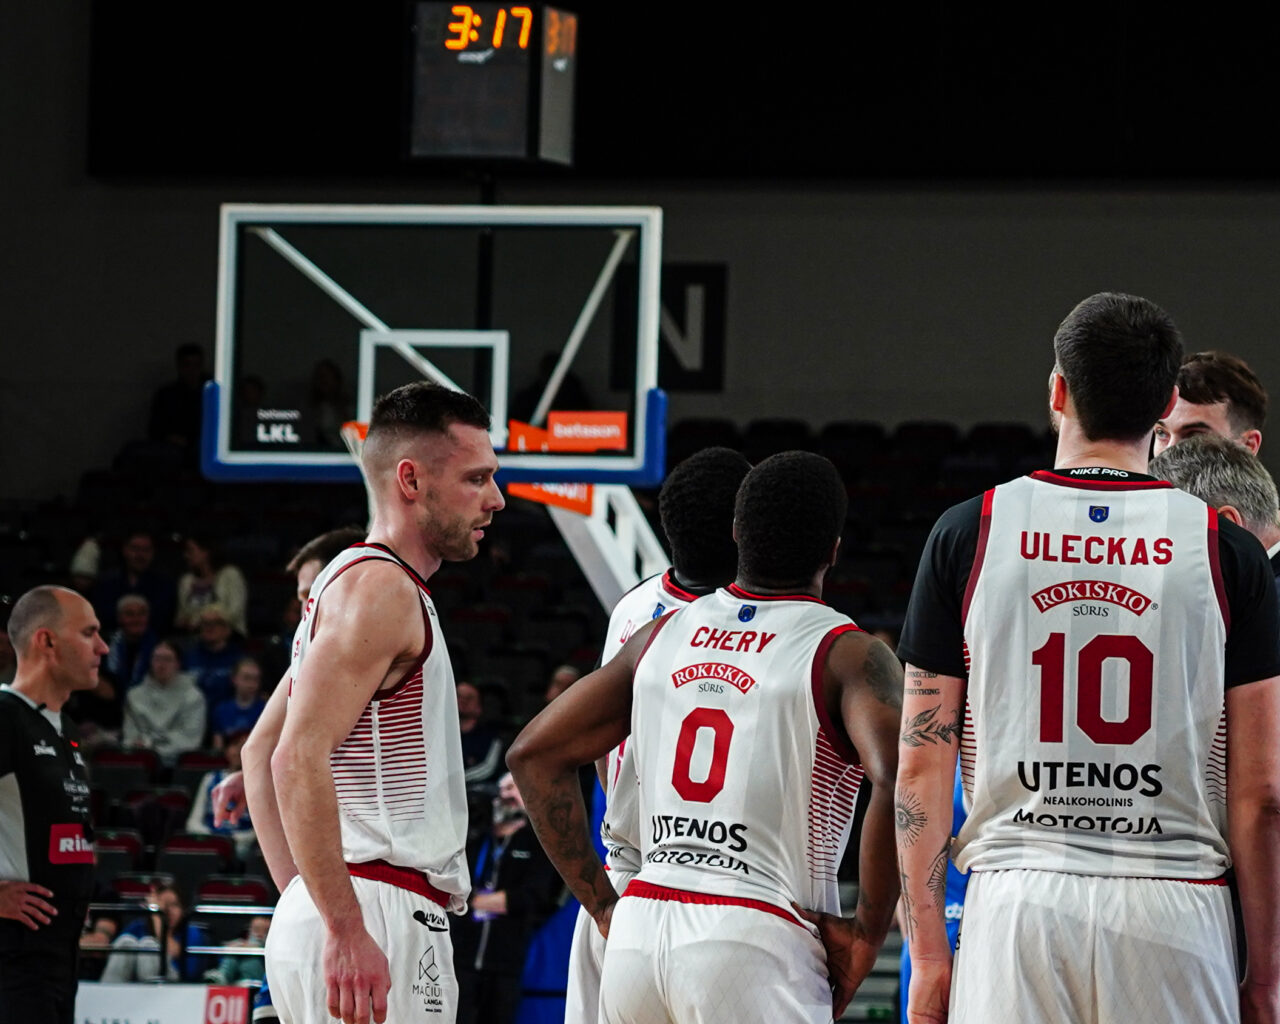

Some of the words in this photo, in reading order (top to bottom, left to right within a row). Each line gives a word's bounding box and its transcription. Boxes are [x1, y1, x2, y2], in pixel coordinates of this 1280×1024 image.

[445, 5, 533, 49] 3:17
[257, 424, 298, 443] LKL
[1070, 467, 1099, 475] NIKE
[1101, 468, 1129, 478] PRO
[1020, 531, 1174, 565] ULECKAS
[690, 626, 777, 653] CHERY
[1032, 632, 1154, 744] 10
[671, 707, 735, 803] 0
[1018, 761, 1163, 797] UTENOS
[1043, 796, 1133, 807] NEALKOHOLINIS
[652, 815, 749, 852] UTENOS
[1013, 808, 1163, 834] MOTOTOJA
